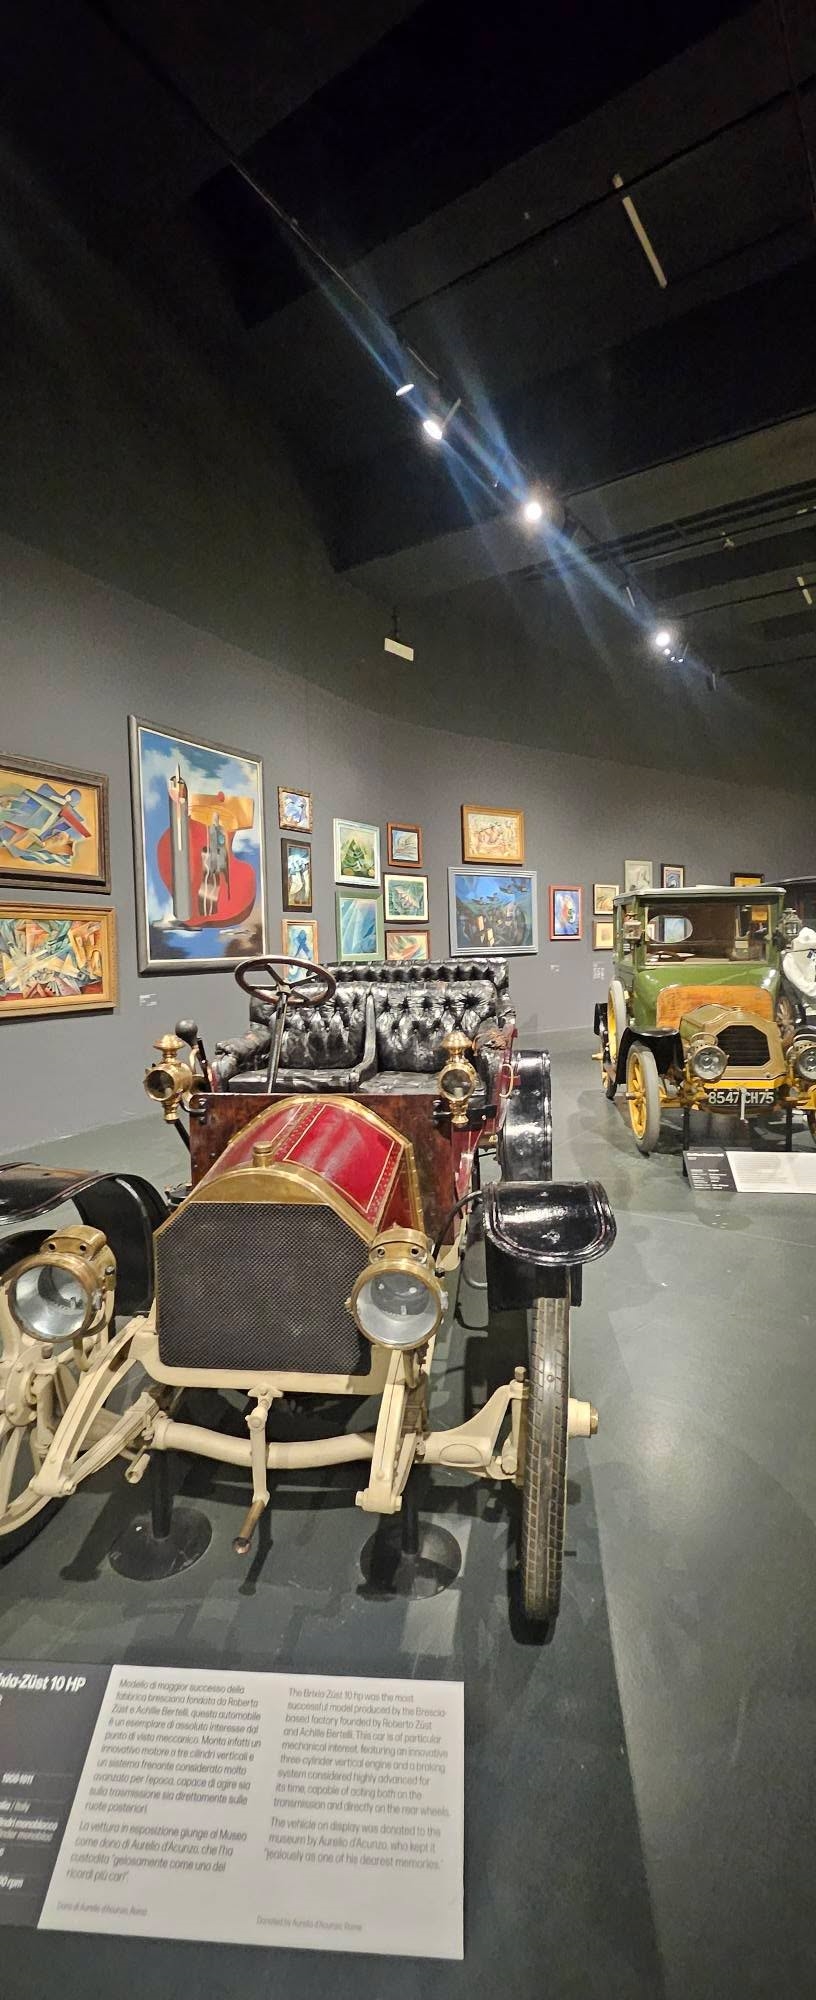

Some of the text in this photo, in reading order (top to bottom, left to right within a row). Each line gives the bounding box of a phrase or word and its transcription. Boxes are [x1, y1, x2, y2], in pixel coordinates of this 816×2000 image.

[708, 1092, 774, 1104] 8547 CH75
[50, 1675, 65, 1691] 10
[65, 1676, 87, 1692] HP
